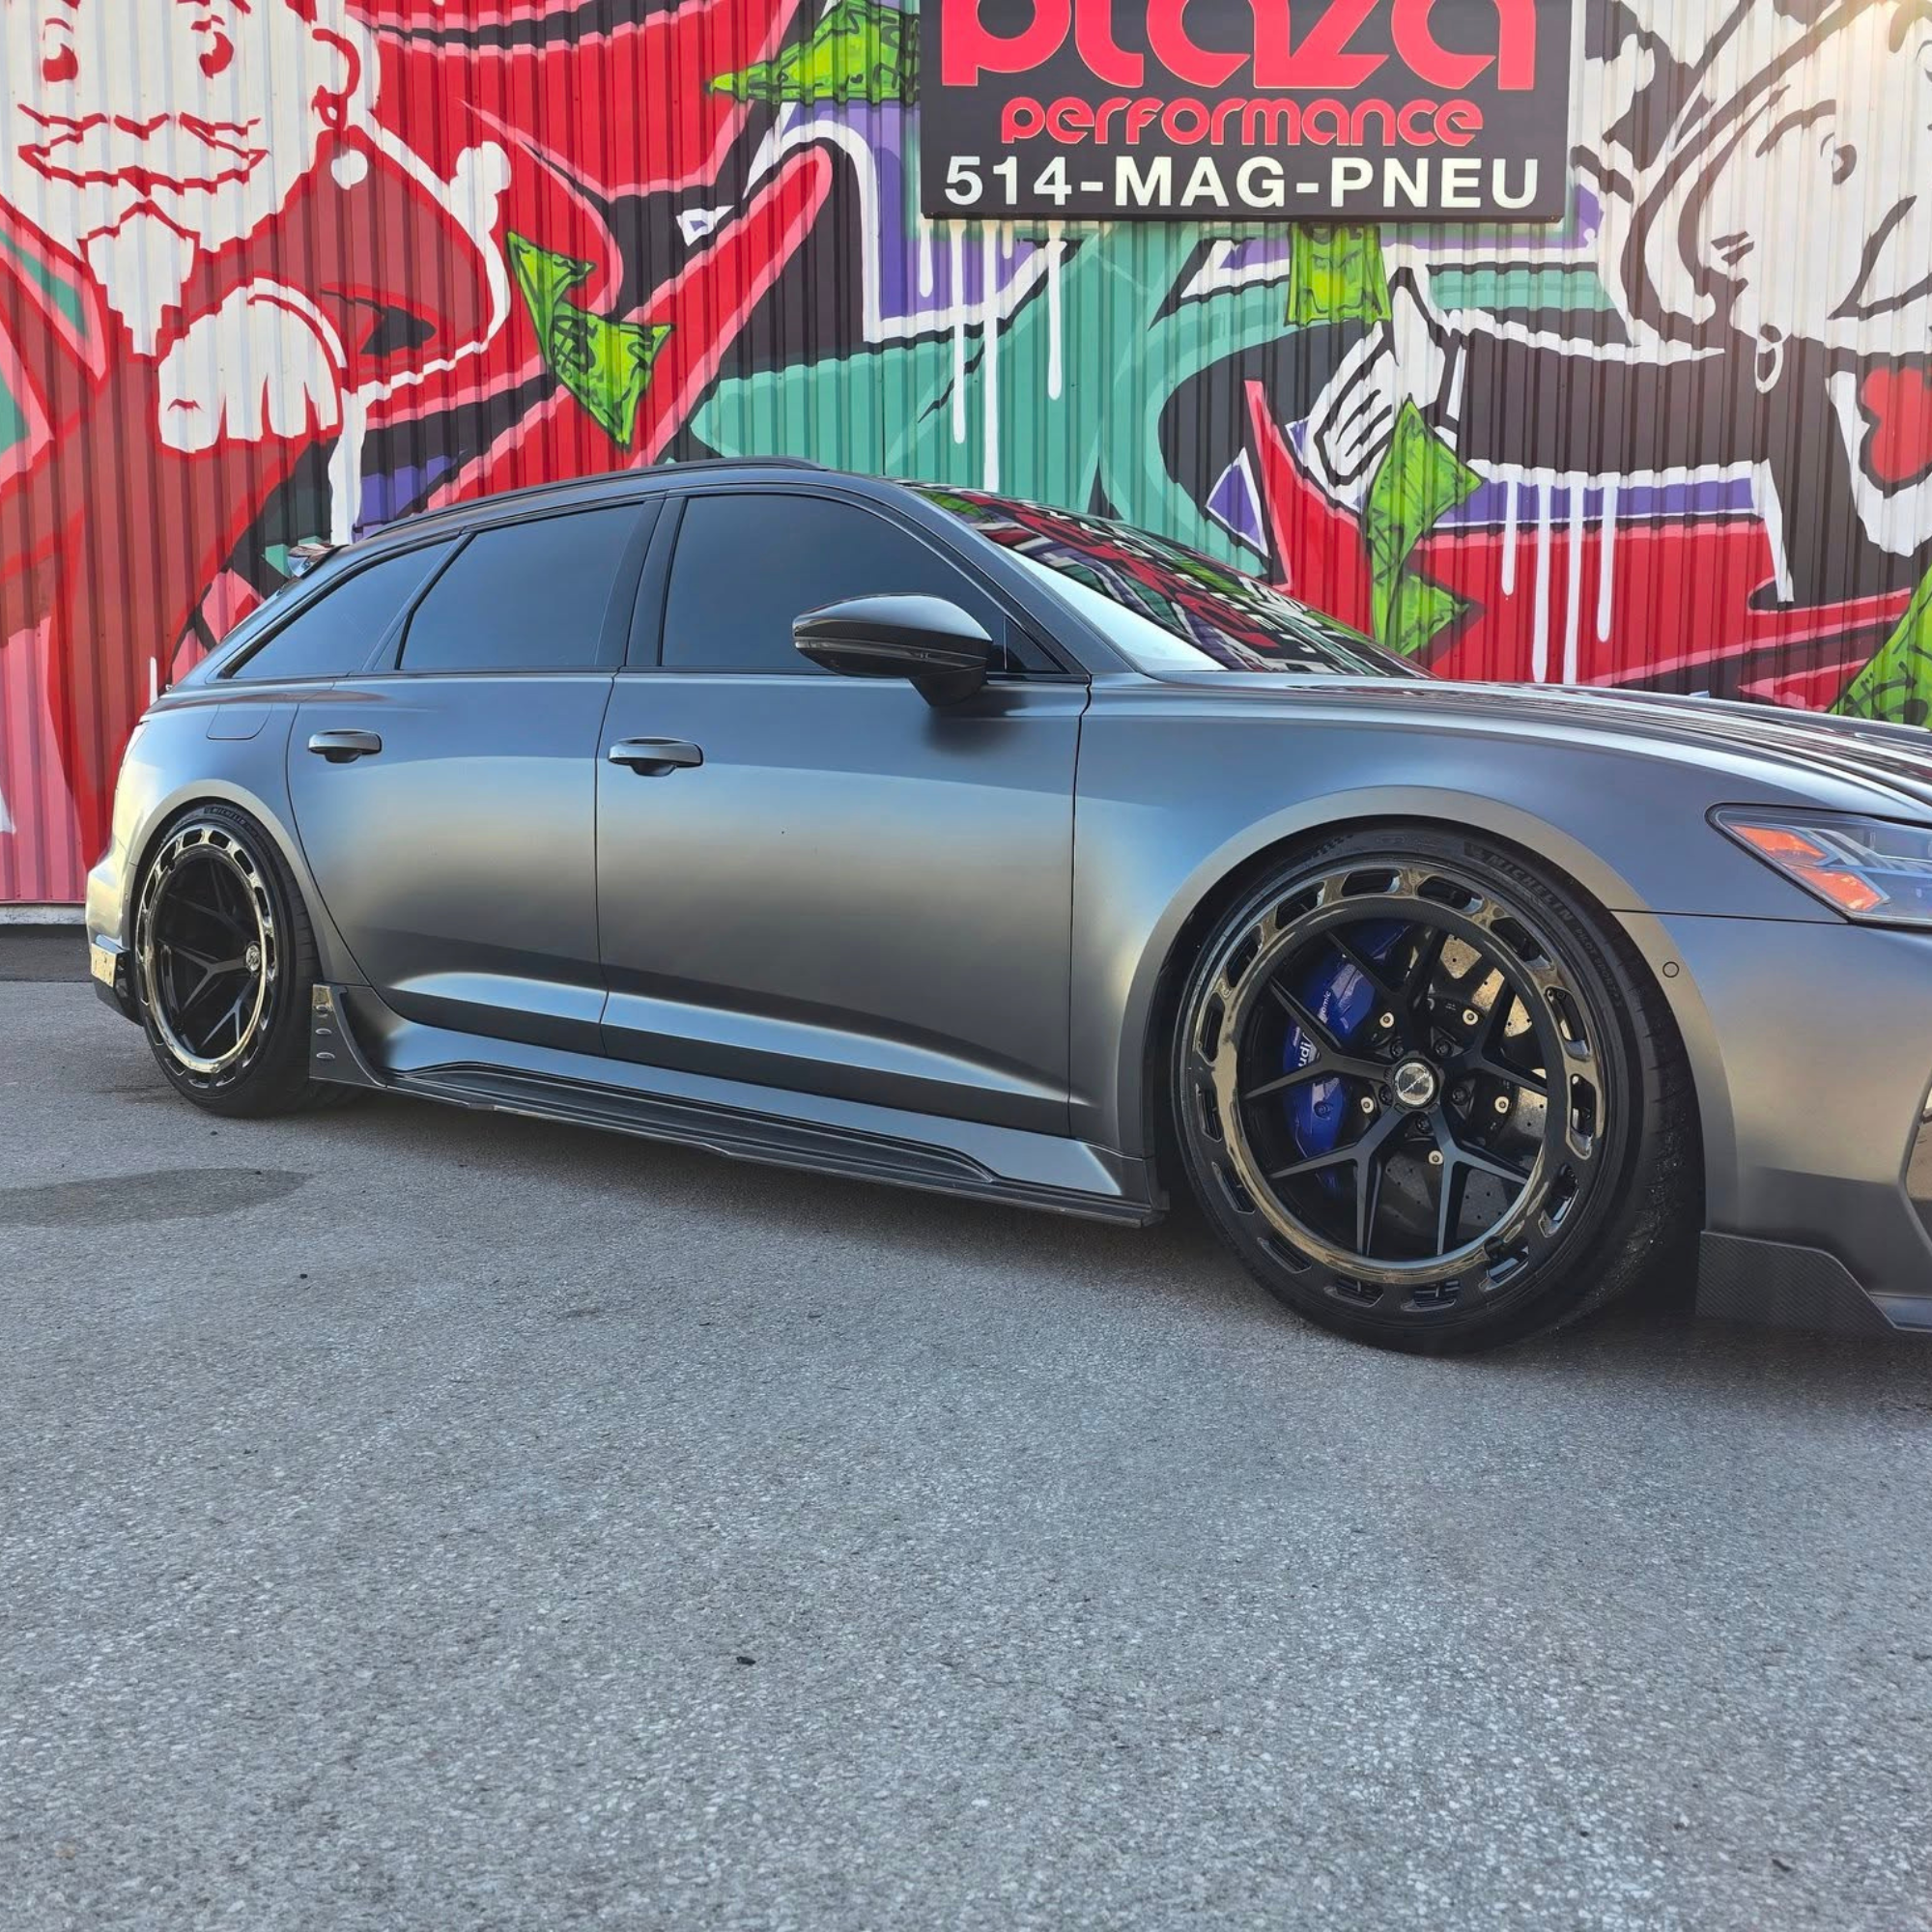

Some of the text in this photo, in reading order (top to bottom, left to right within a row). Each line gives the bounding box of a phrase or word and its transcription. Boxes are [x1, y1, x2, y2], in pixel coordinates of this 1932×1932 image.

[942, 0, 1536, 89] plaza
[1001, 97, 1484, 147] performance
[944, 156, 1539, 208] 514-MAG-PNEU
[1486, 854, 1575, 922] MICHELIN
[1298, 1041, 1312, 1066] udi
